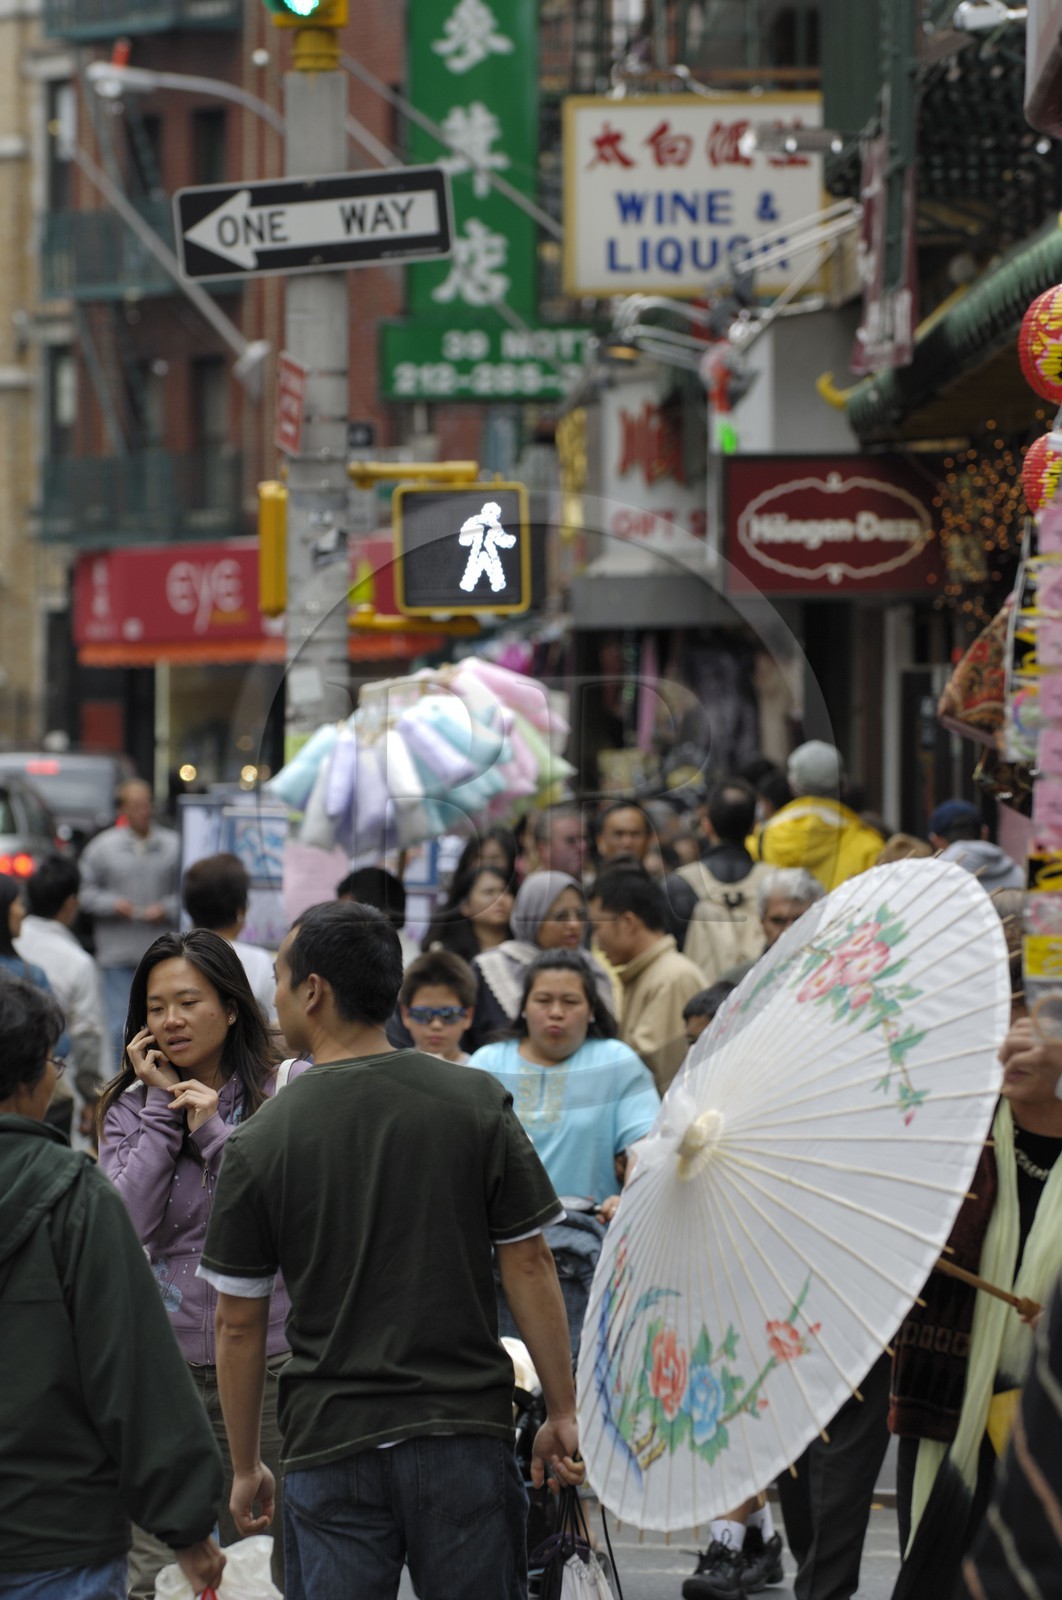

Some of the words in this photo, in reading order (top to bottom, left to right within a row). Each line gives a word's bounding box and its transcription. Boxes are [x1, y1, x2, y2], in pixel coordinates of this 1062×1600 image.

[586, 119, 810, 173] 太白酒
[216, 210, 288, 248] ONE
[339, 197, 414, 236] WAY
[615, 190, 732, 225] WINE
[756, 190, 779, 222] &
